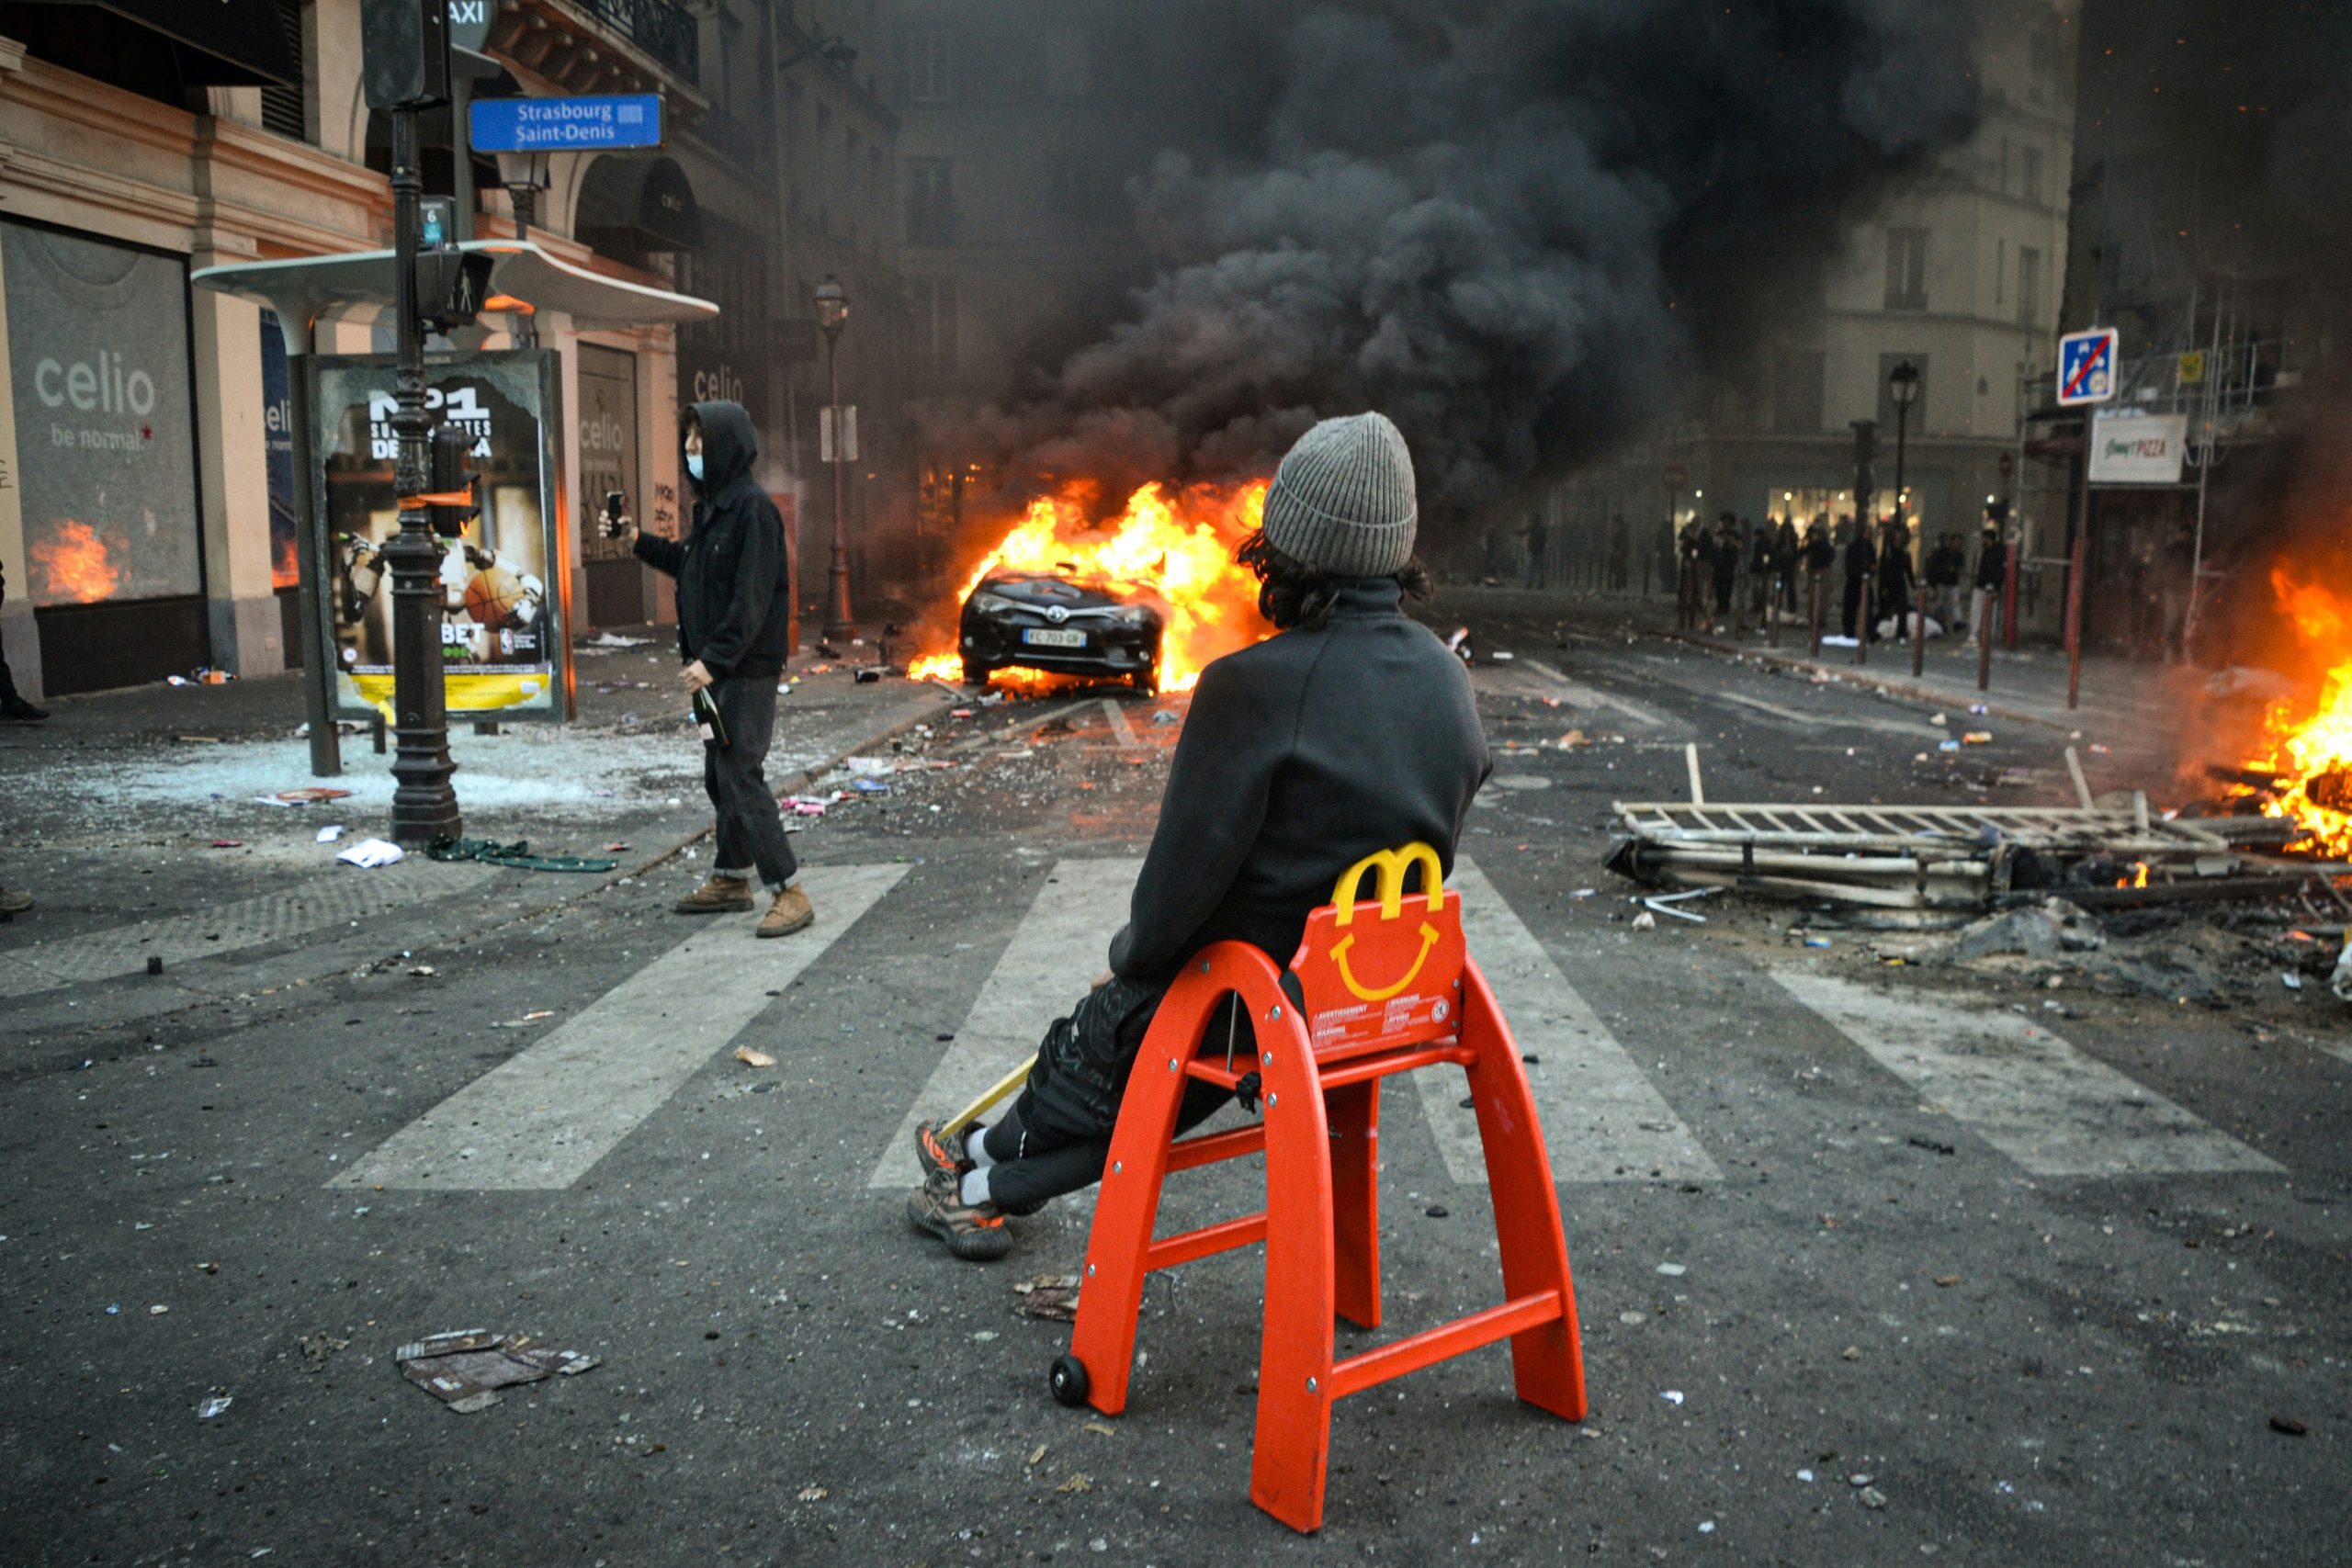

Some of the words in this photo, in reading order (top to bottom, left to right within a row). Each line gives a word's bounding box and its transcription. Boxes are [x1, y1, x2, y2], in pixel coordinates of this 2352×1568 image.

[449, 1, 483, 24] AXI
[517, 104, 612, 121] Strasbourg
[515, 123, 615, 141] Saint-Denis
[35, 351, 155, 415] celio
[695, 365, 743, 402] celio
[265, 399, 292, 432] eli
[51, 423, 74, 446] be
[580, 414, 623, 450] celio
[1318, 1004, 1368, 1020] AVERTISSEMENT
